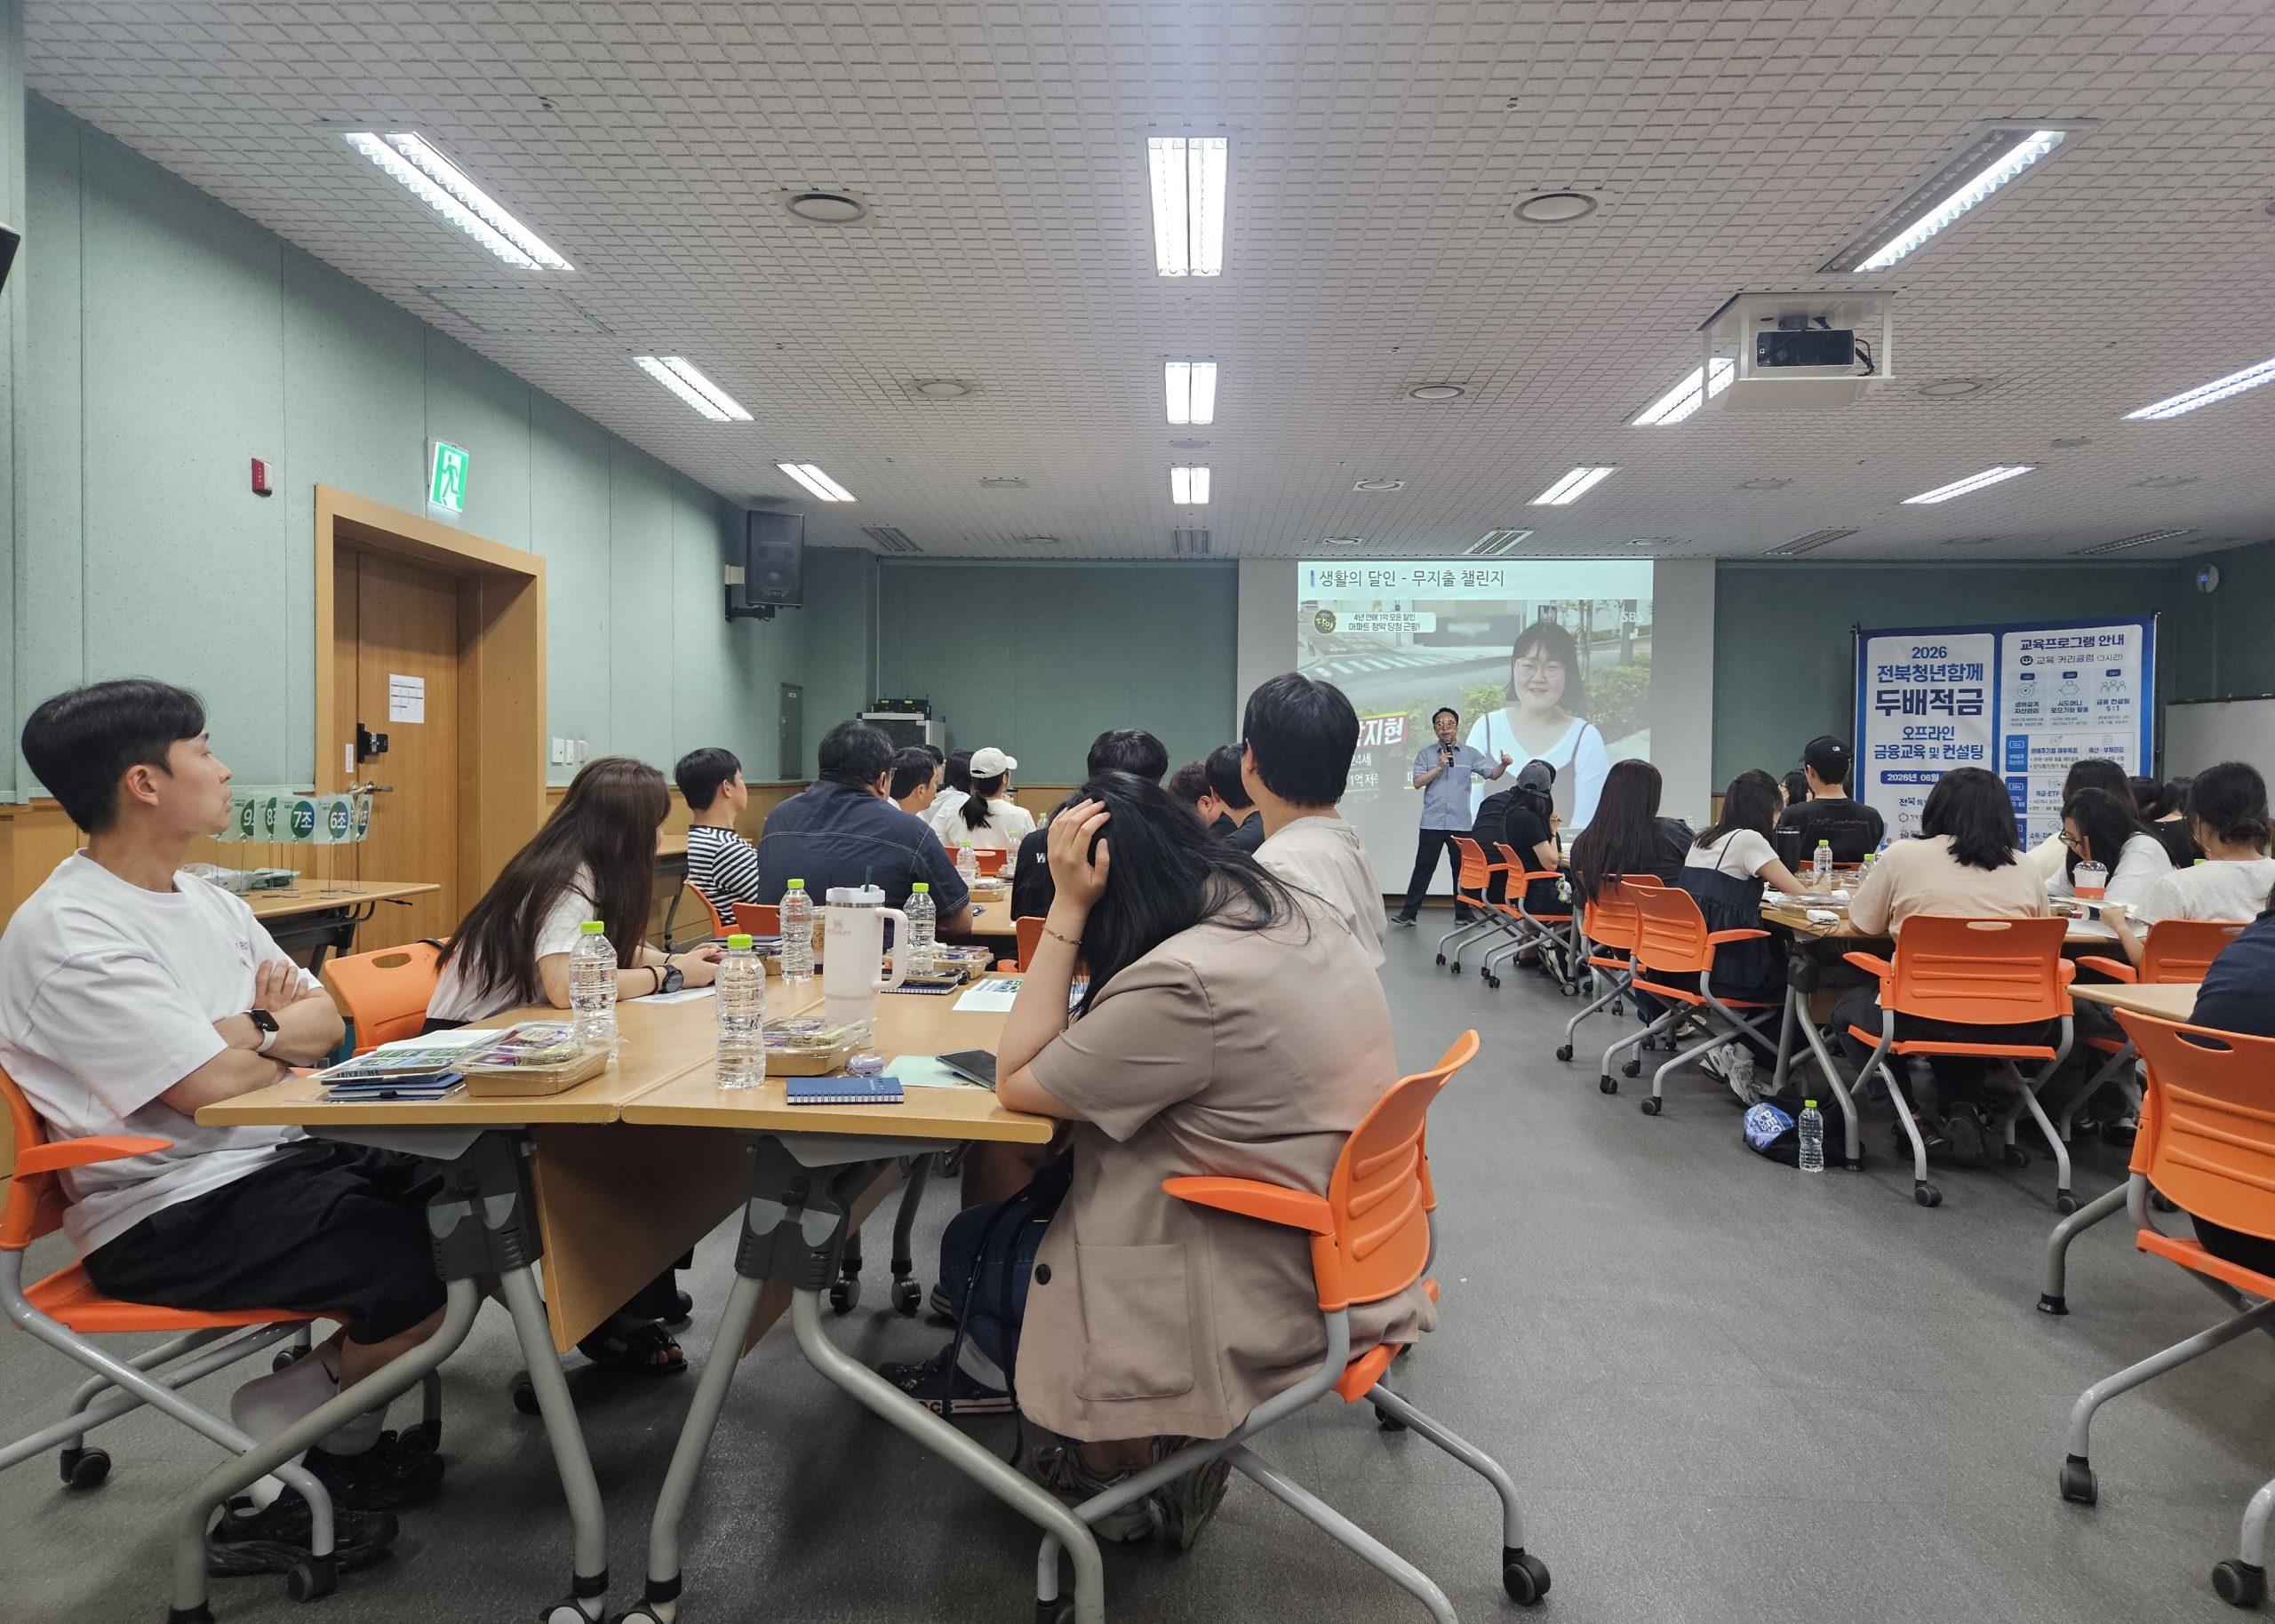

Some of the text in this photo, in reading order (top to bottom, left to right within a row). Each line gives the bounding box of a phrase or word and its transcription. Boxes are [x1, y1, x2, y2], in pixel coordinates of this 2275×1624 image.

[1319, 569, 1362, 587] 생활의
[1368, 569, 1397, 587] 달인
[1411, 569, 1457, 587] 무지출
[1460, 569, 1505, 587] 챌린지
[1348, 622, 1370, 631] 아파트
[1371, 622, 1386, 631] 청약
[1387, 622, 1402, 631] 당첨
[2020, 633, 2125, 650] 교육프로그램 안내
[1912, 646, 1948, 659] 2026
[2036, 653, 2124, 665] 교육 커리큘럼 (3시간)
[1877, 662, 1984, 683] 전북청년함께
[1875, 689, 1984, 717] 두배적금
[1902, 726, 1955, 741] 오프라인
[1874, 744, 1984, 760] 금융교육 및 컨설팅
[1350, 775, 1363, 787] 1억
[1887, 773, 1940, 783] 2026년 06월
[243, 808, 255, 826] 9
[293, 810, 312, 828] 7조
[330, 811, 347, 829] 6조
